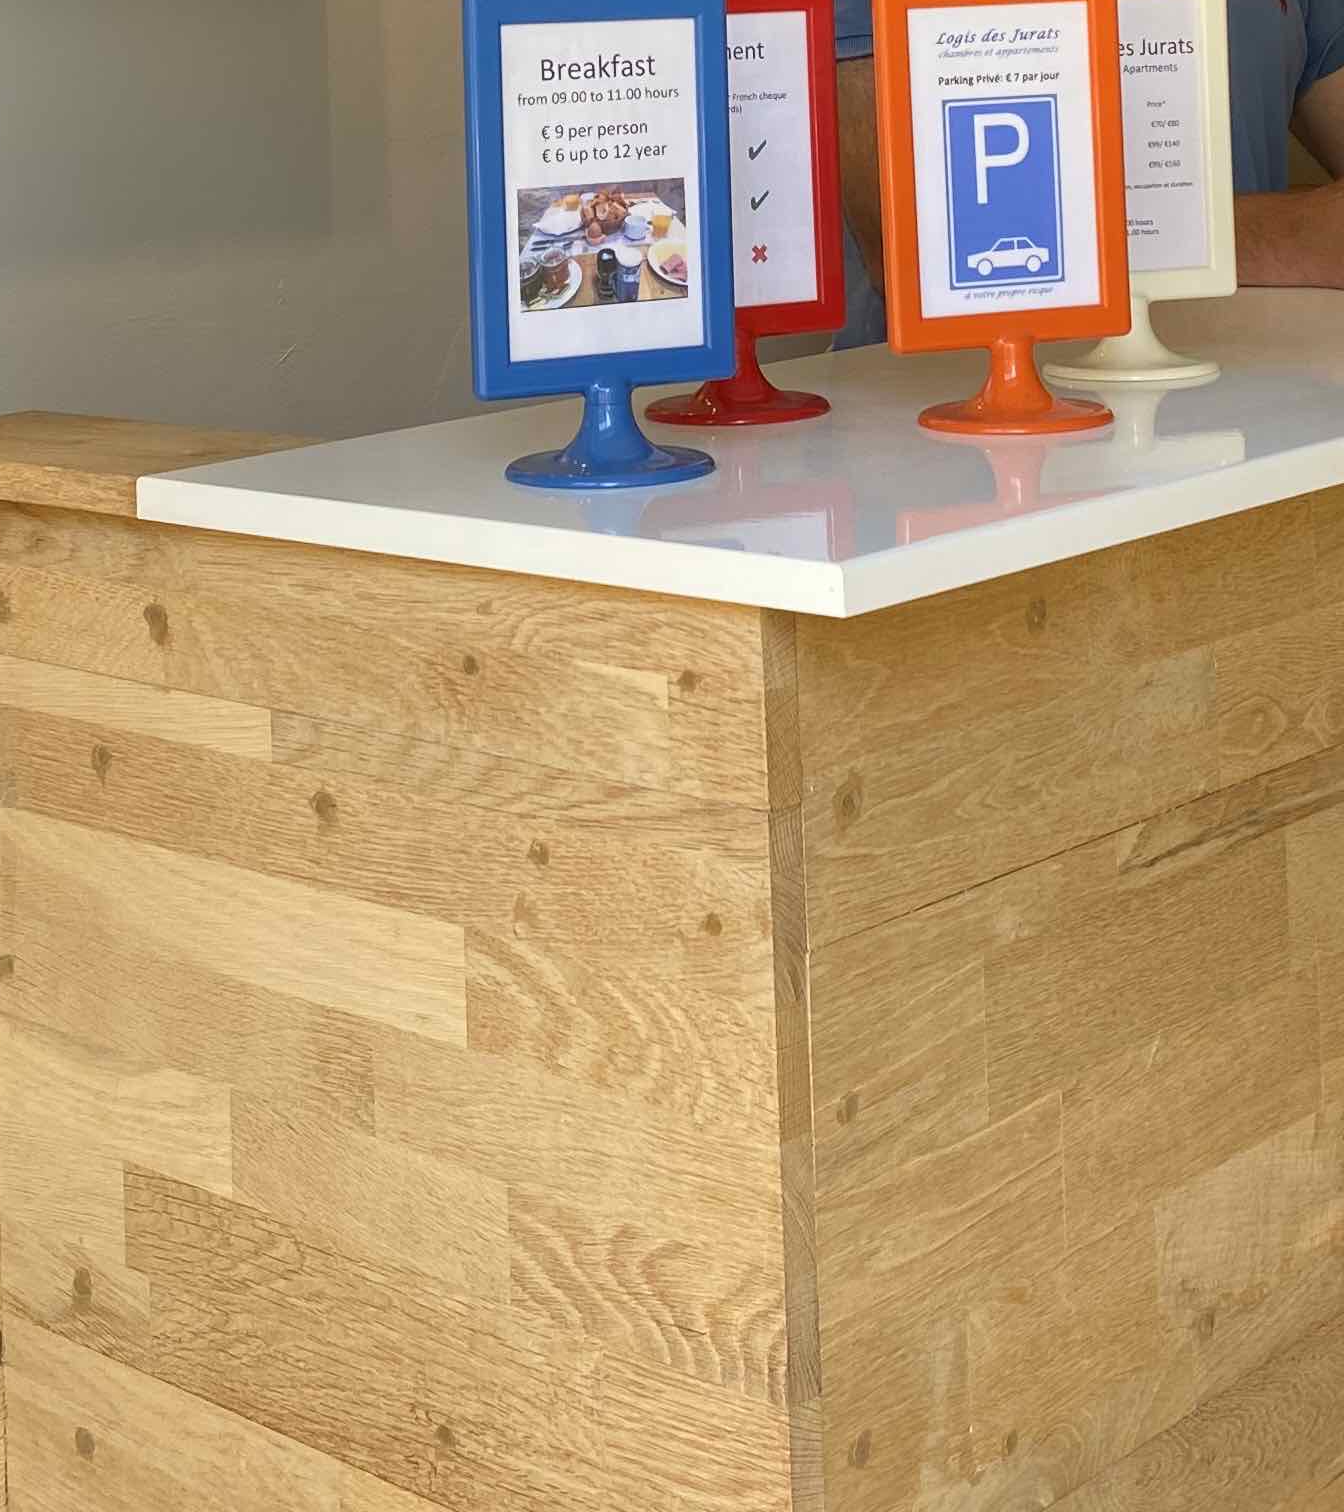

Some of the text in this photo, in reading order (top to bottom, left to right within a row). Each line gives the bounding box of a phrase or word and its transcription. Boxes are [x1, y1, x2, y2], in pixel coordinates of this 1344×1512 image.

[936, 27, 1060, 48] Logis des Jurats
[1139, 38, 1194, 56] Jurats
[540, 53, 656, 81] Breakfast
[1123, 63, 1178, 75] Apartments
[938, 75, 974, 87] Parking
[1006, 72, 1012, 82] €
[1014, 72, 1020, 82] 7
[1022, 71, 1038, 83] par
[1040, 71, 1060, 83] jour
[518, 93, 547, 107] from
[591, 91, 603, 103] to
[607, 88, 641, 102] 11.00
[644, 86, 679, 100] hours
[541, 121, 648, 141] € 9 per person
[542, 143, 668, 164] € 6 up to 12 year
[973, 111, 1031, 206] P
